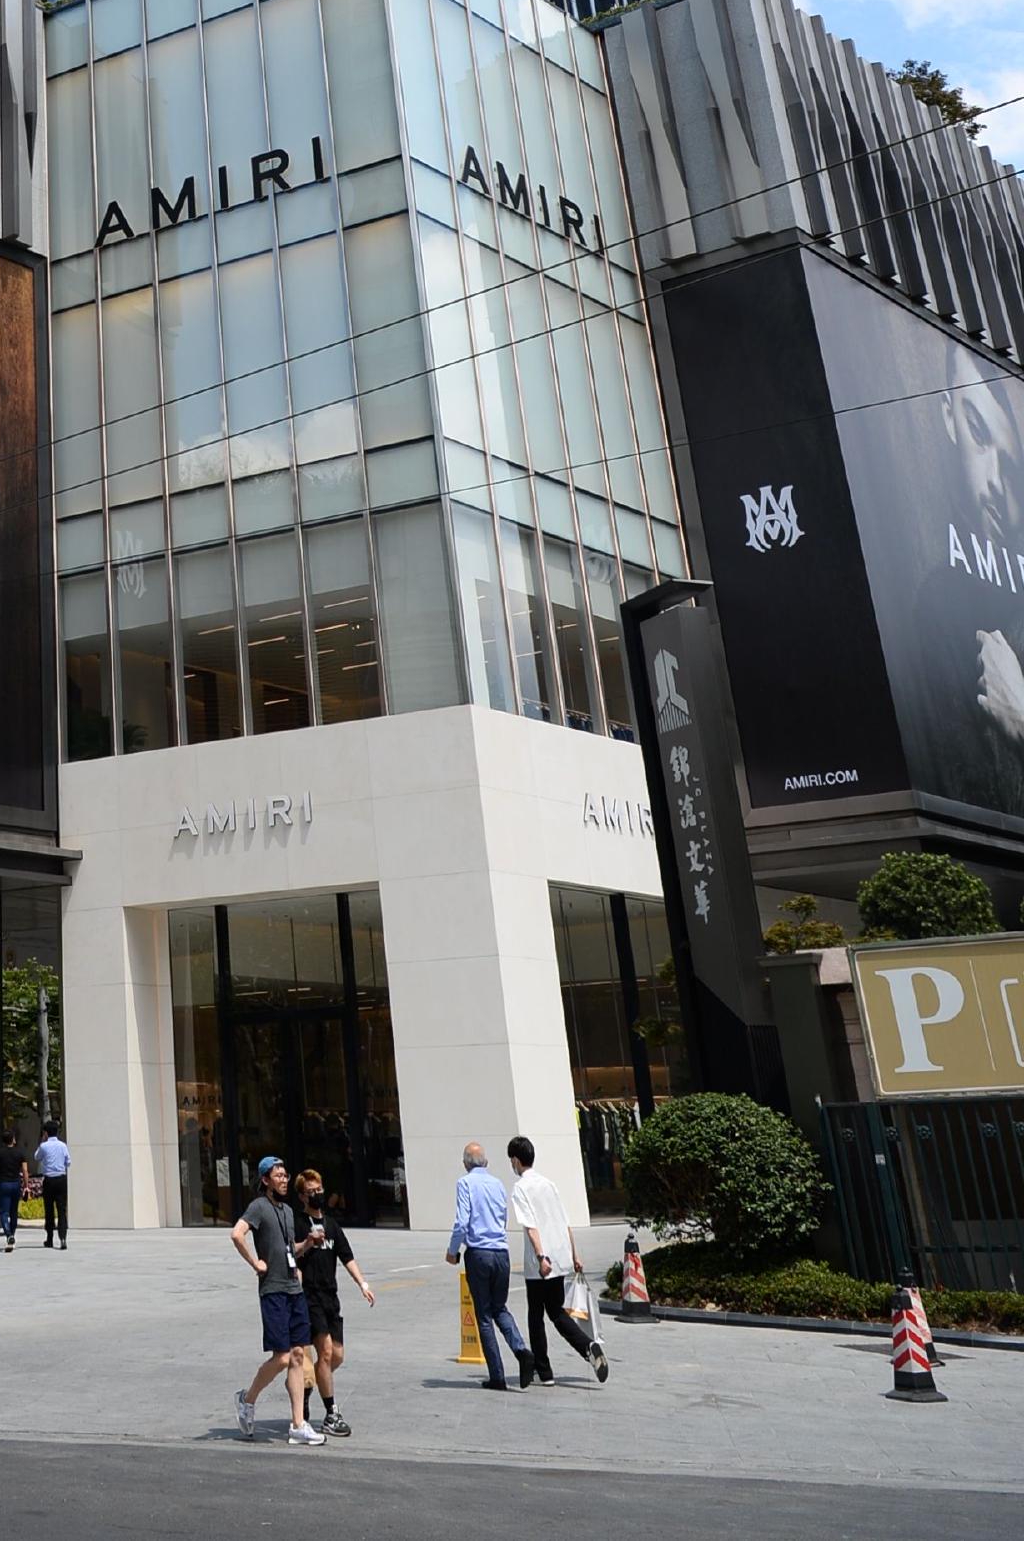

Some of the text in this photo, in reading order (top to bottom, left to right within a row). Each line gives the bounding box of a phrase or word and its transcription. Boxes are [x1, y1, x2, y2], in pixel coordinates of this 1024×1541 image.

[94, 136, 325, 249] AMIRI
[461, 145, 605, 256] AMIRI
[174, 790, 312, 838] AMIRI
[583, 792, 654, 837] AMIR
[784, 769, 859, 791] AMIRI.COM
[874, 966, 965, 1073] P
